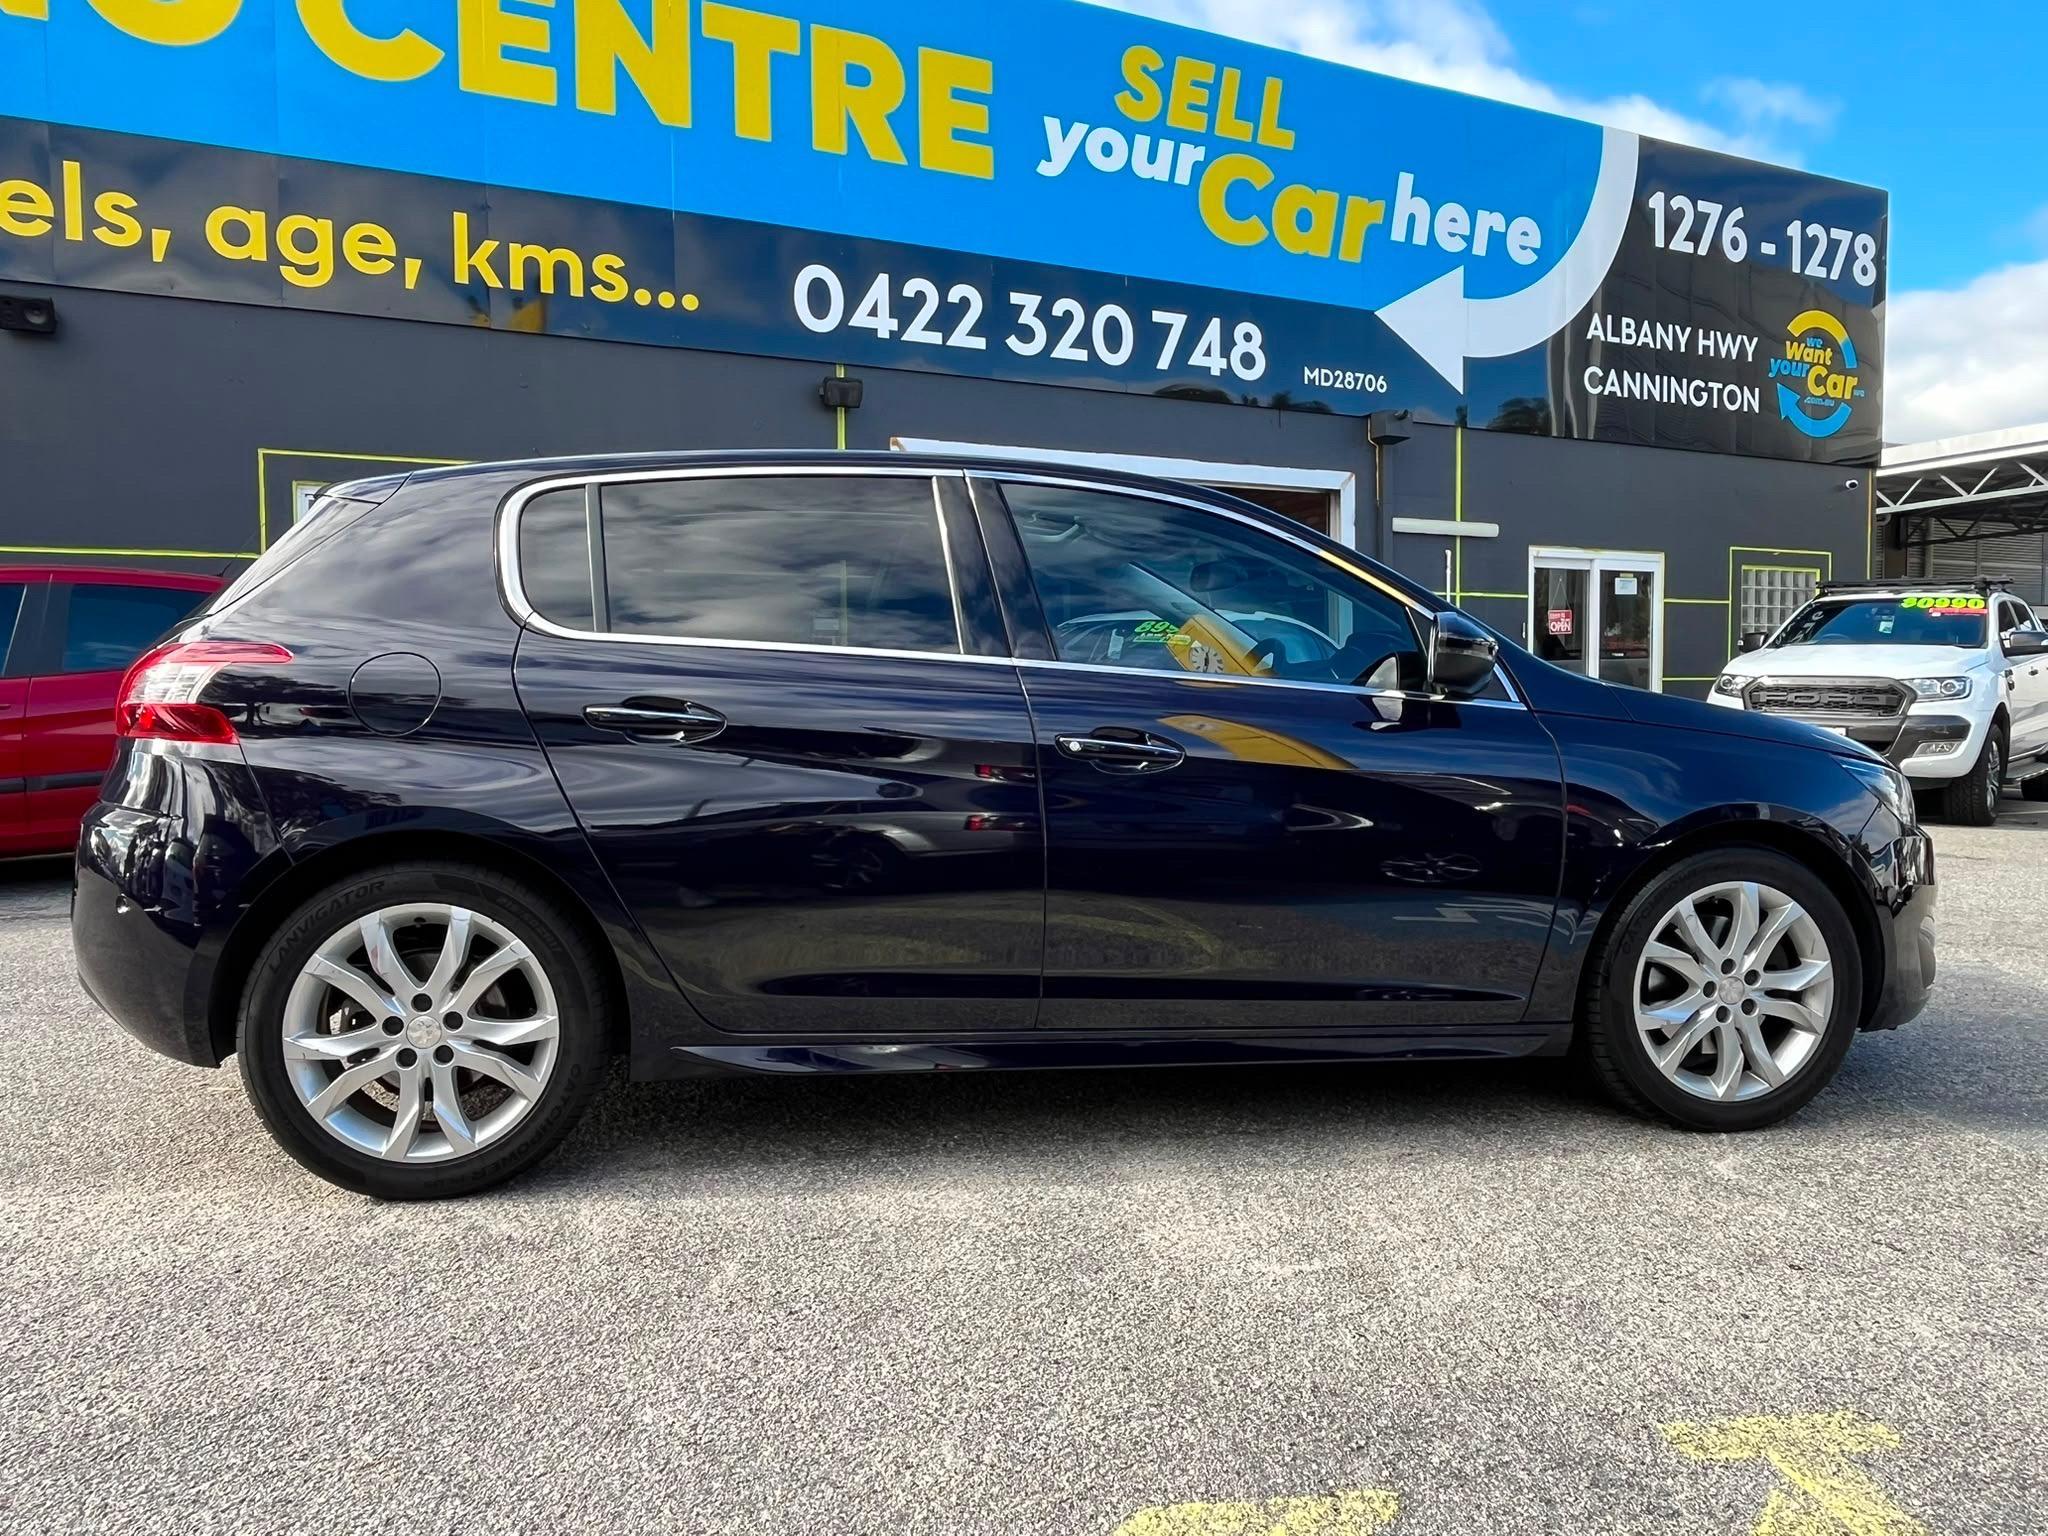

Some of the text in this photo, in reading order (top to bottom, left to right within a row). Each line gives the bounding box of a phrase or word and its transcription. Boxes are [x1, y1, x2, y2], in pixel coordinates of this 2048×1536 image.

[1114, 44, 1296, 150] SELL
[1036, 115, 1542, 266] your Car here
[0, 160, 700, 312] els, age, kms...
[1648, 191, 1748, 263] 1276
[1786, 219, 1878, 287] 1278
[792, 263, 1267, 382] 0422 320 748
[1586, 312, 1759, 362] ALBANY HWY
[1806, 337, 1823, 348] we
[1786, 341, 1832, 365] Want
[1303, 365, 1388, 394] MD28706
[1583, 365, 1760, 414] CANNINGTON
[1769, 358, 1858, 399] your Car
[1550, 621, 1571, 632] OPEN
[1759, 691, 1887, 706] FORD
[268, 880, 385, 975] LANVIGATOR
